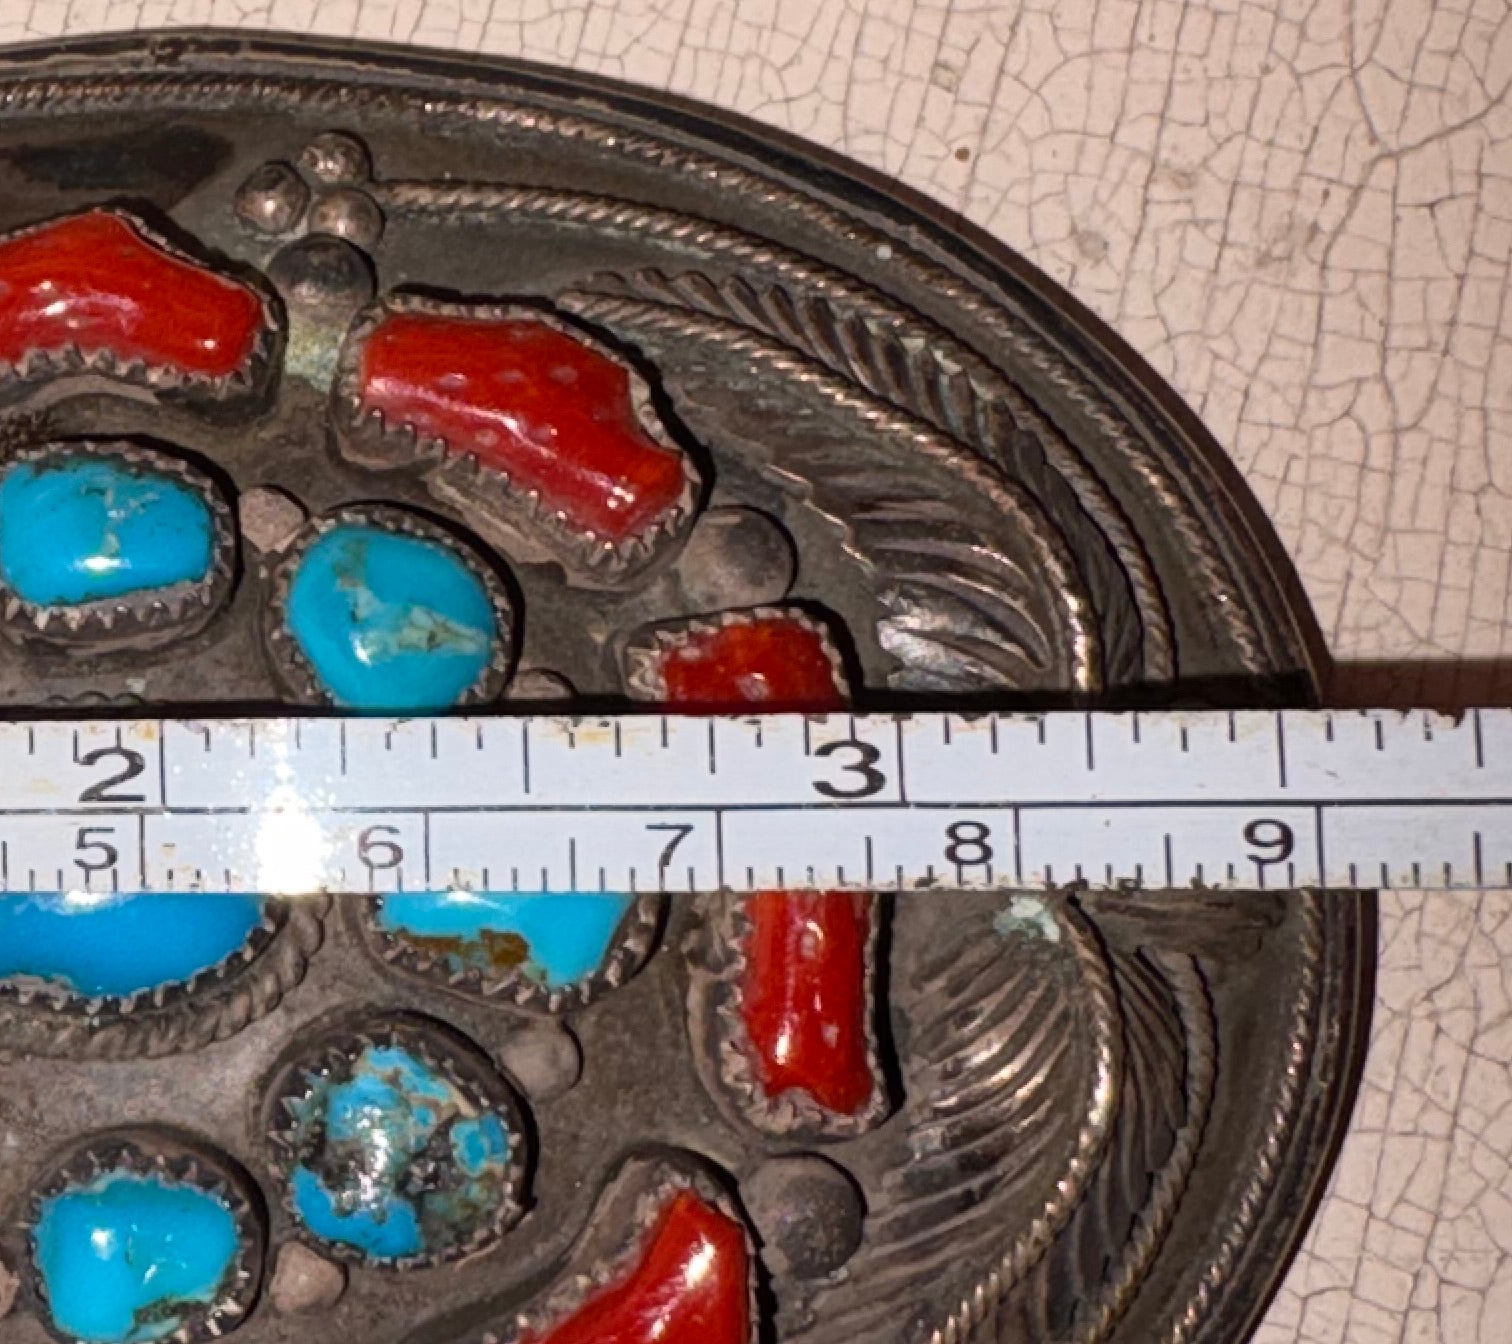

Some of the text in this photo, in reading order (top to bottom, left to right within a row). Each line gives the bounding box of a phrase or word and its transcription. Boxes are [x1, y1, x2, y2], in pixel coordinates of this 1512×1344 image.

[78, 746, 146, 803] 2
[812, 739, 887, 799] 3
[73, 826, 118, 871] 5
[356, 824, 404, 869] 6
[645, 824, 693, 866] 7
[944, 821, 993, 866] 8
[1243, 818, 1295, 865] 9
